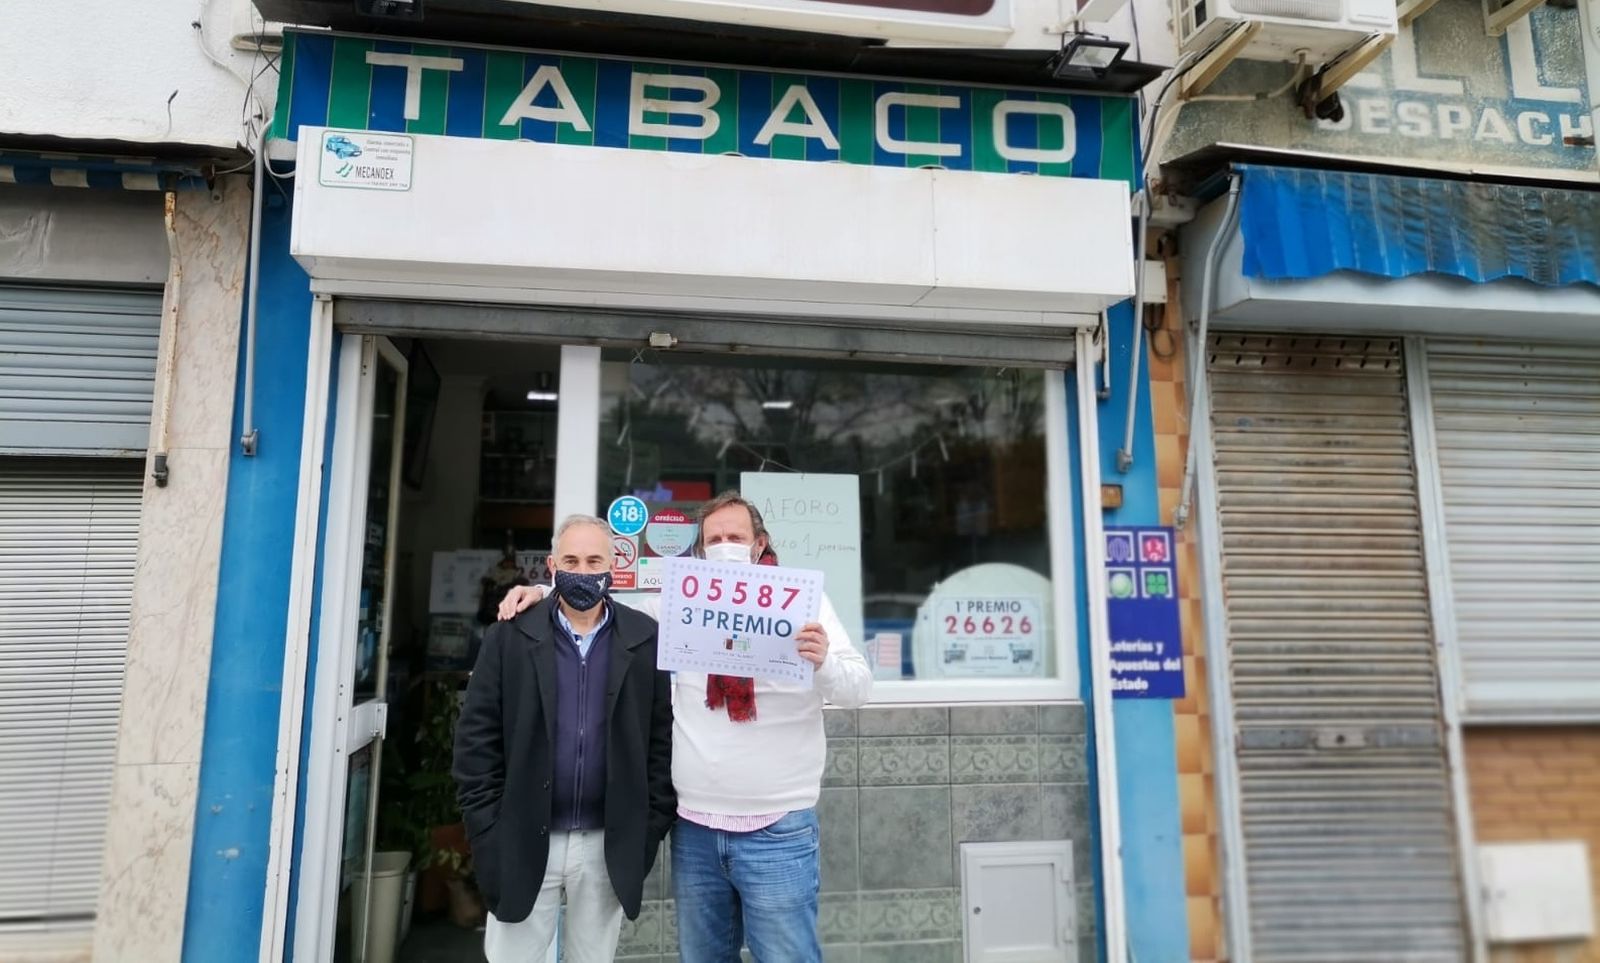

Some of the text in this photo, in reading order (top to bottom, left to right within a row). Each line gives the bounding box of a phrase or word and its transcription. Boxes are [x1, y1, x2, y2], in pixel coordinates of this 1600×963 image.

[365, 50, 1077, 164] TABACO
[613, 505, 638, 523] +18
[763, 497, 839, 520] AFORO
[681, 575, 800, 611] 05587
[967, 601, 1022, 613] PREMIO
[702, 609, 793, 638] PREMIO
[944, 615, 1033, 635] 26626
[1156, 642, 1164, 655] y
[1163, 657, 1181, 671] del
